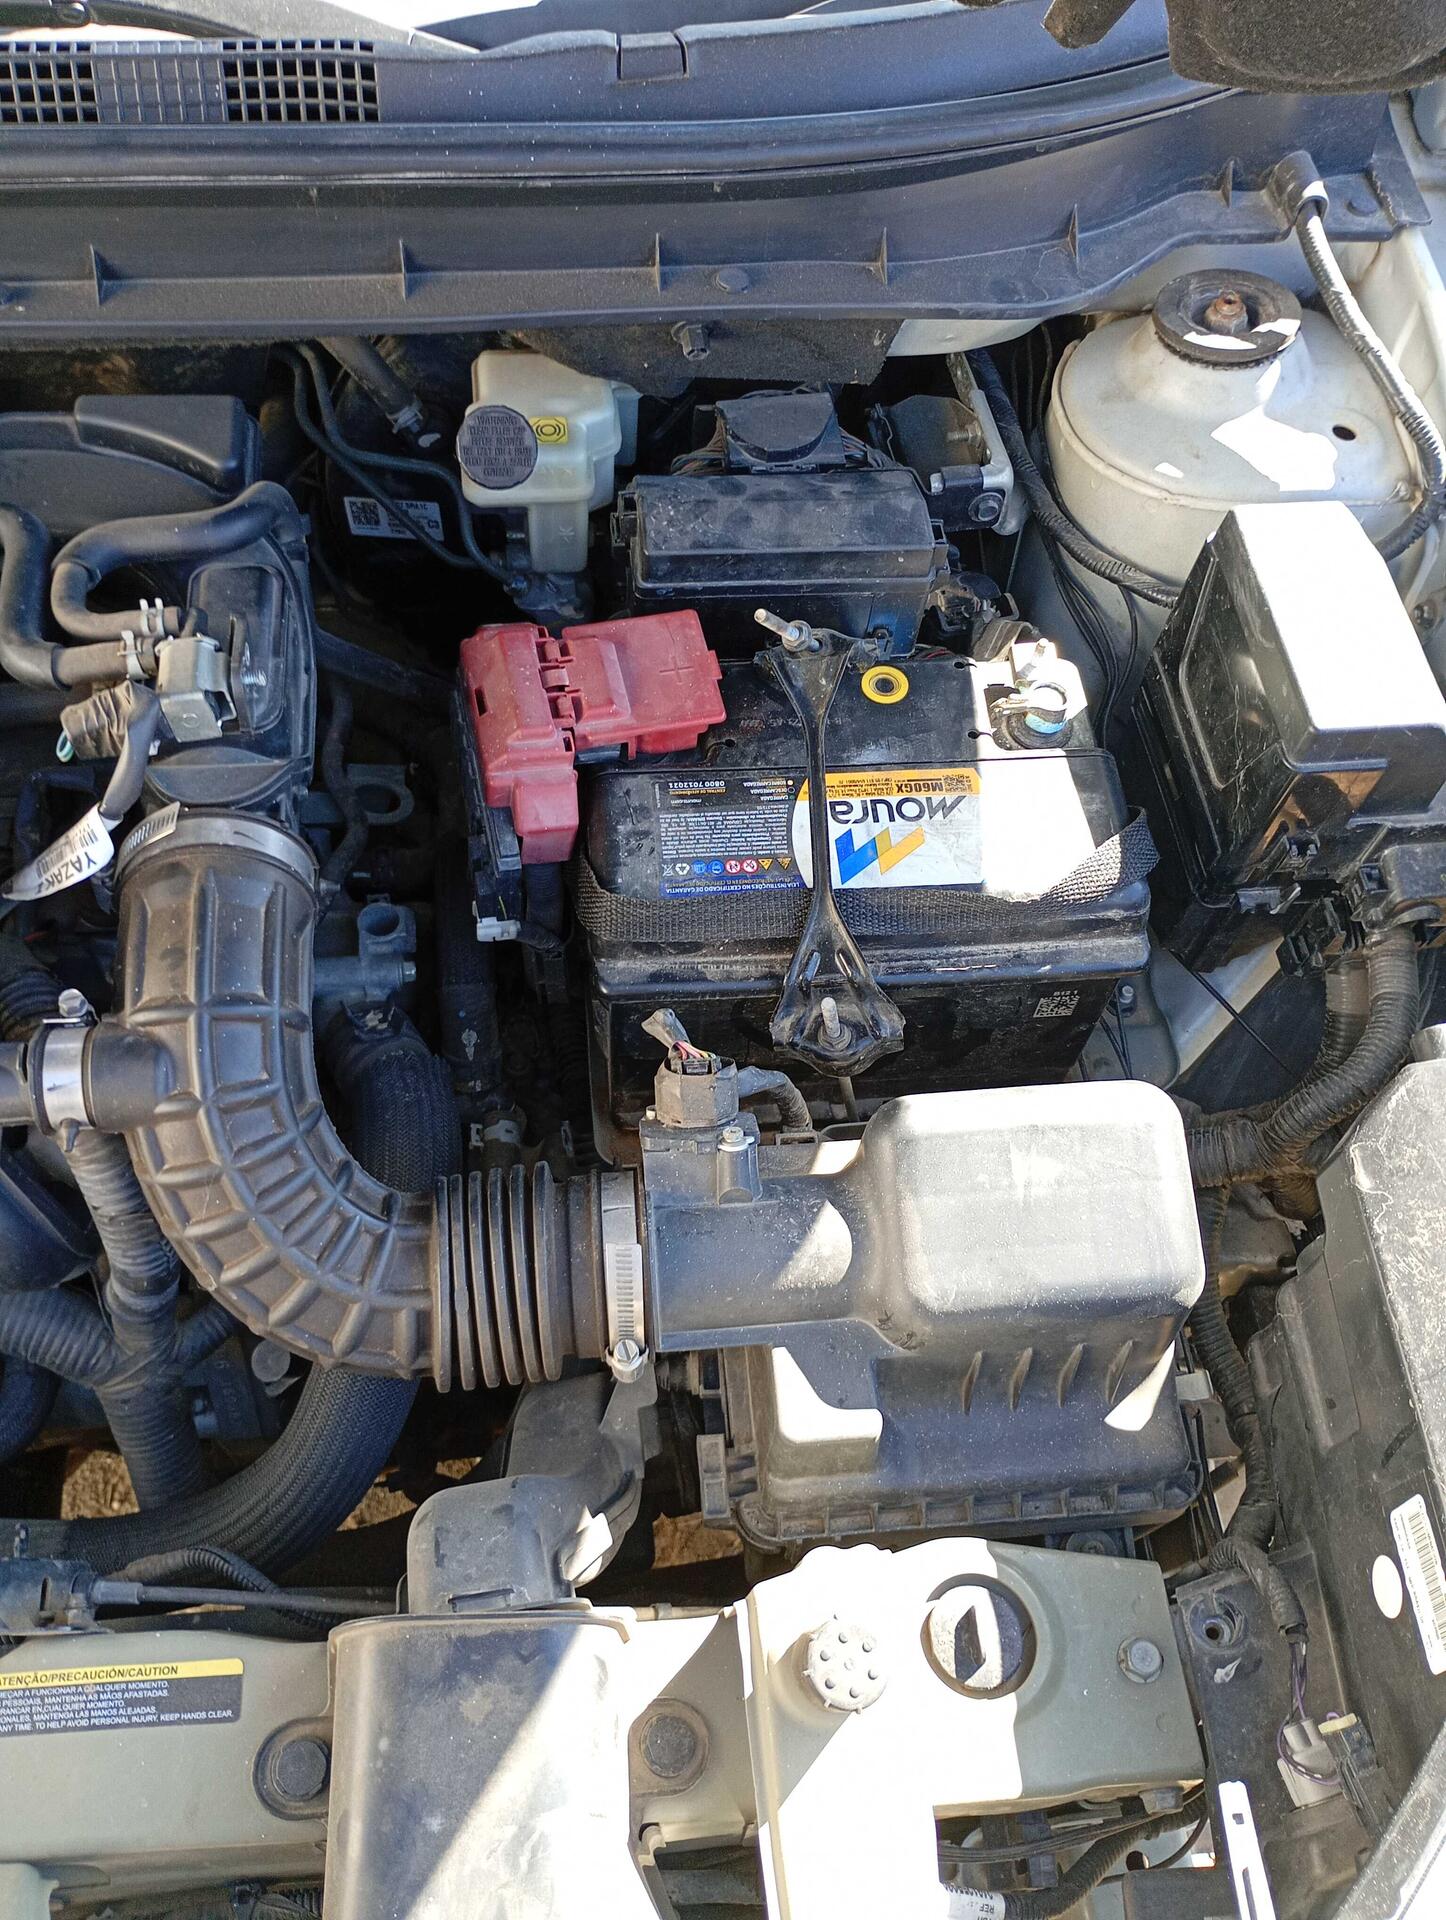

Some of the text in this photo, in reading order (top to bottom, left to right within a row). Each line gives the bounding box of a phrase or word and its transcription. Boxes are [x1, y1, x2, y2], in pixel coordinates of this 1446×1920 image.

[476, 416, 518, 426] WARNING
[896, 782, 944, 794] M60GX
[704, 884, 741, 892] CERTIFICADO
[0, 1665, 178, 1686] TENÇÃO/PRECAUCIÓN/CAUTION
[32, 1686, 76, 1696] FUNCIONAR
[91, 1708, 118, 1717] MANOS
[47, 1720, 66, 1729] HELP
[67, 1719, 90, 1728] AVOID
[91, 1716, 130, 1726] PERSONAL
[160, 1713, 180, 1722] KEEP
[181, 1711, 206, 1720] HANDS
